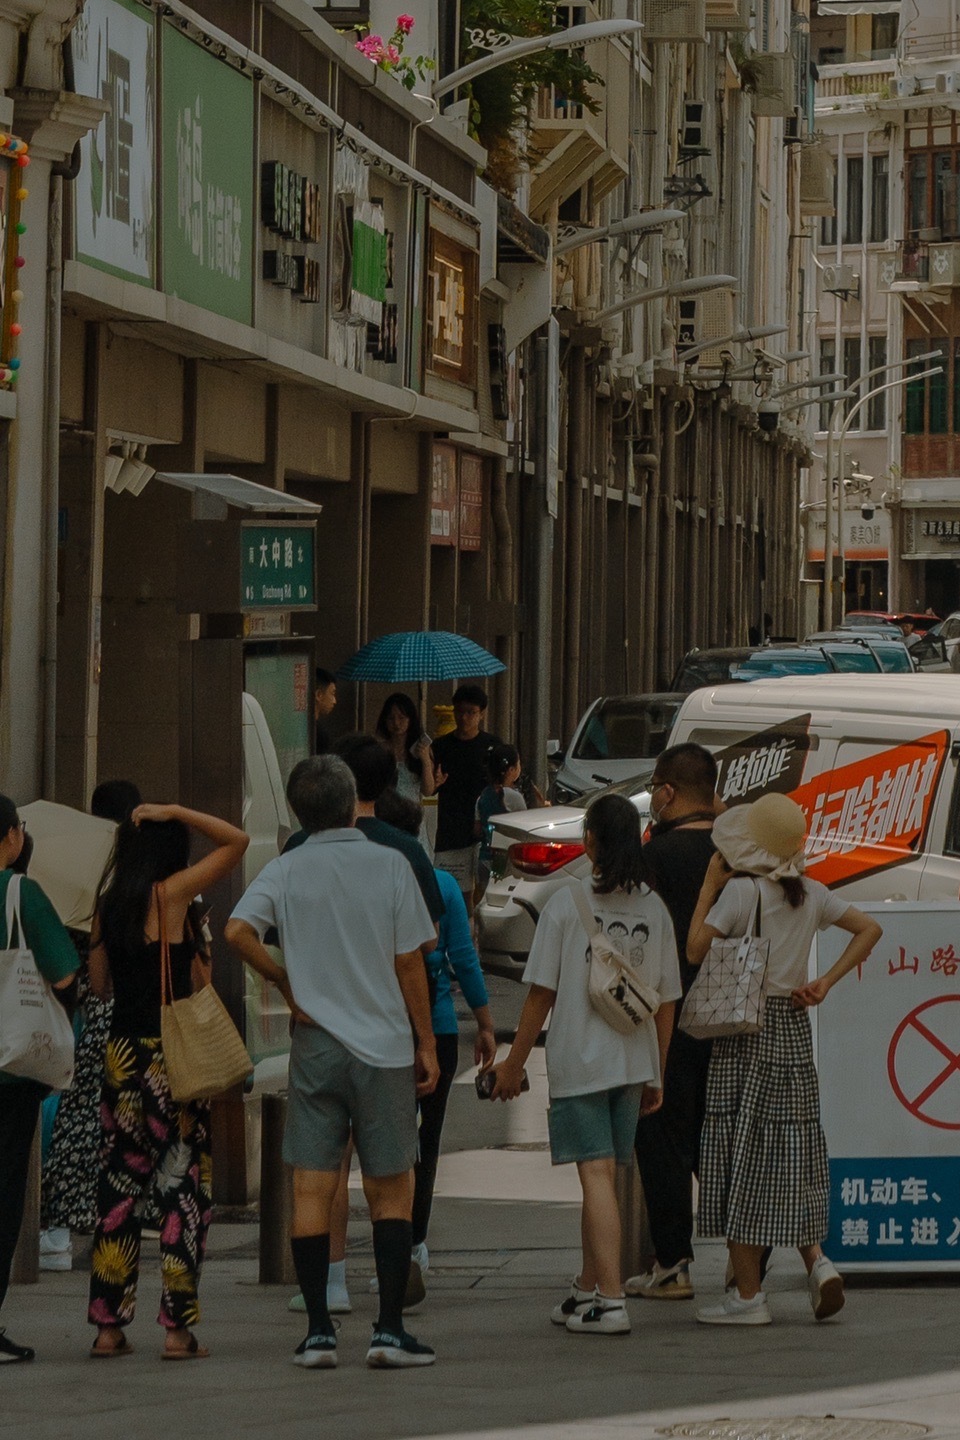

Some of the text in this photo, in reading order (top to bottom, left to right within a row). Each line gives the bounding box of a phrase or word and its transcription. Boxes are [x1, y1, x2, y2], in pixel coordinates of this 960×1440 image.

[259, 537, 294, 569] 大中路
[714, 738, 797, 803] 货拉拉
[801, 753, 937, 866] 运啥都快
